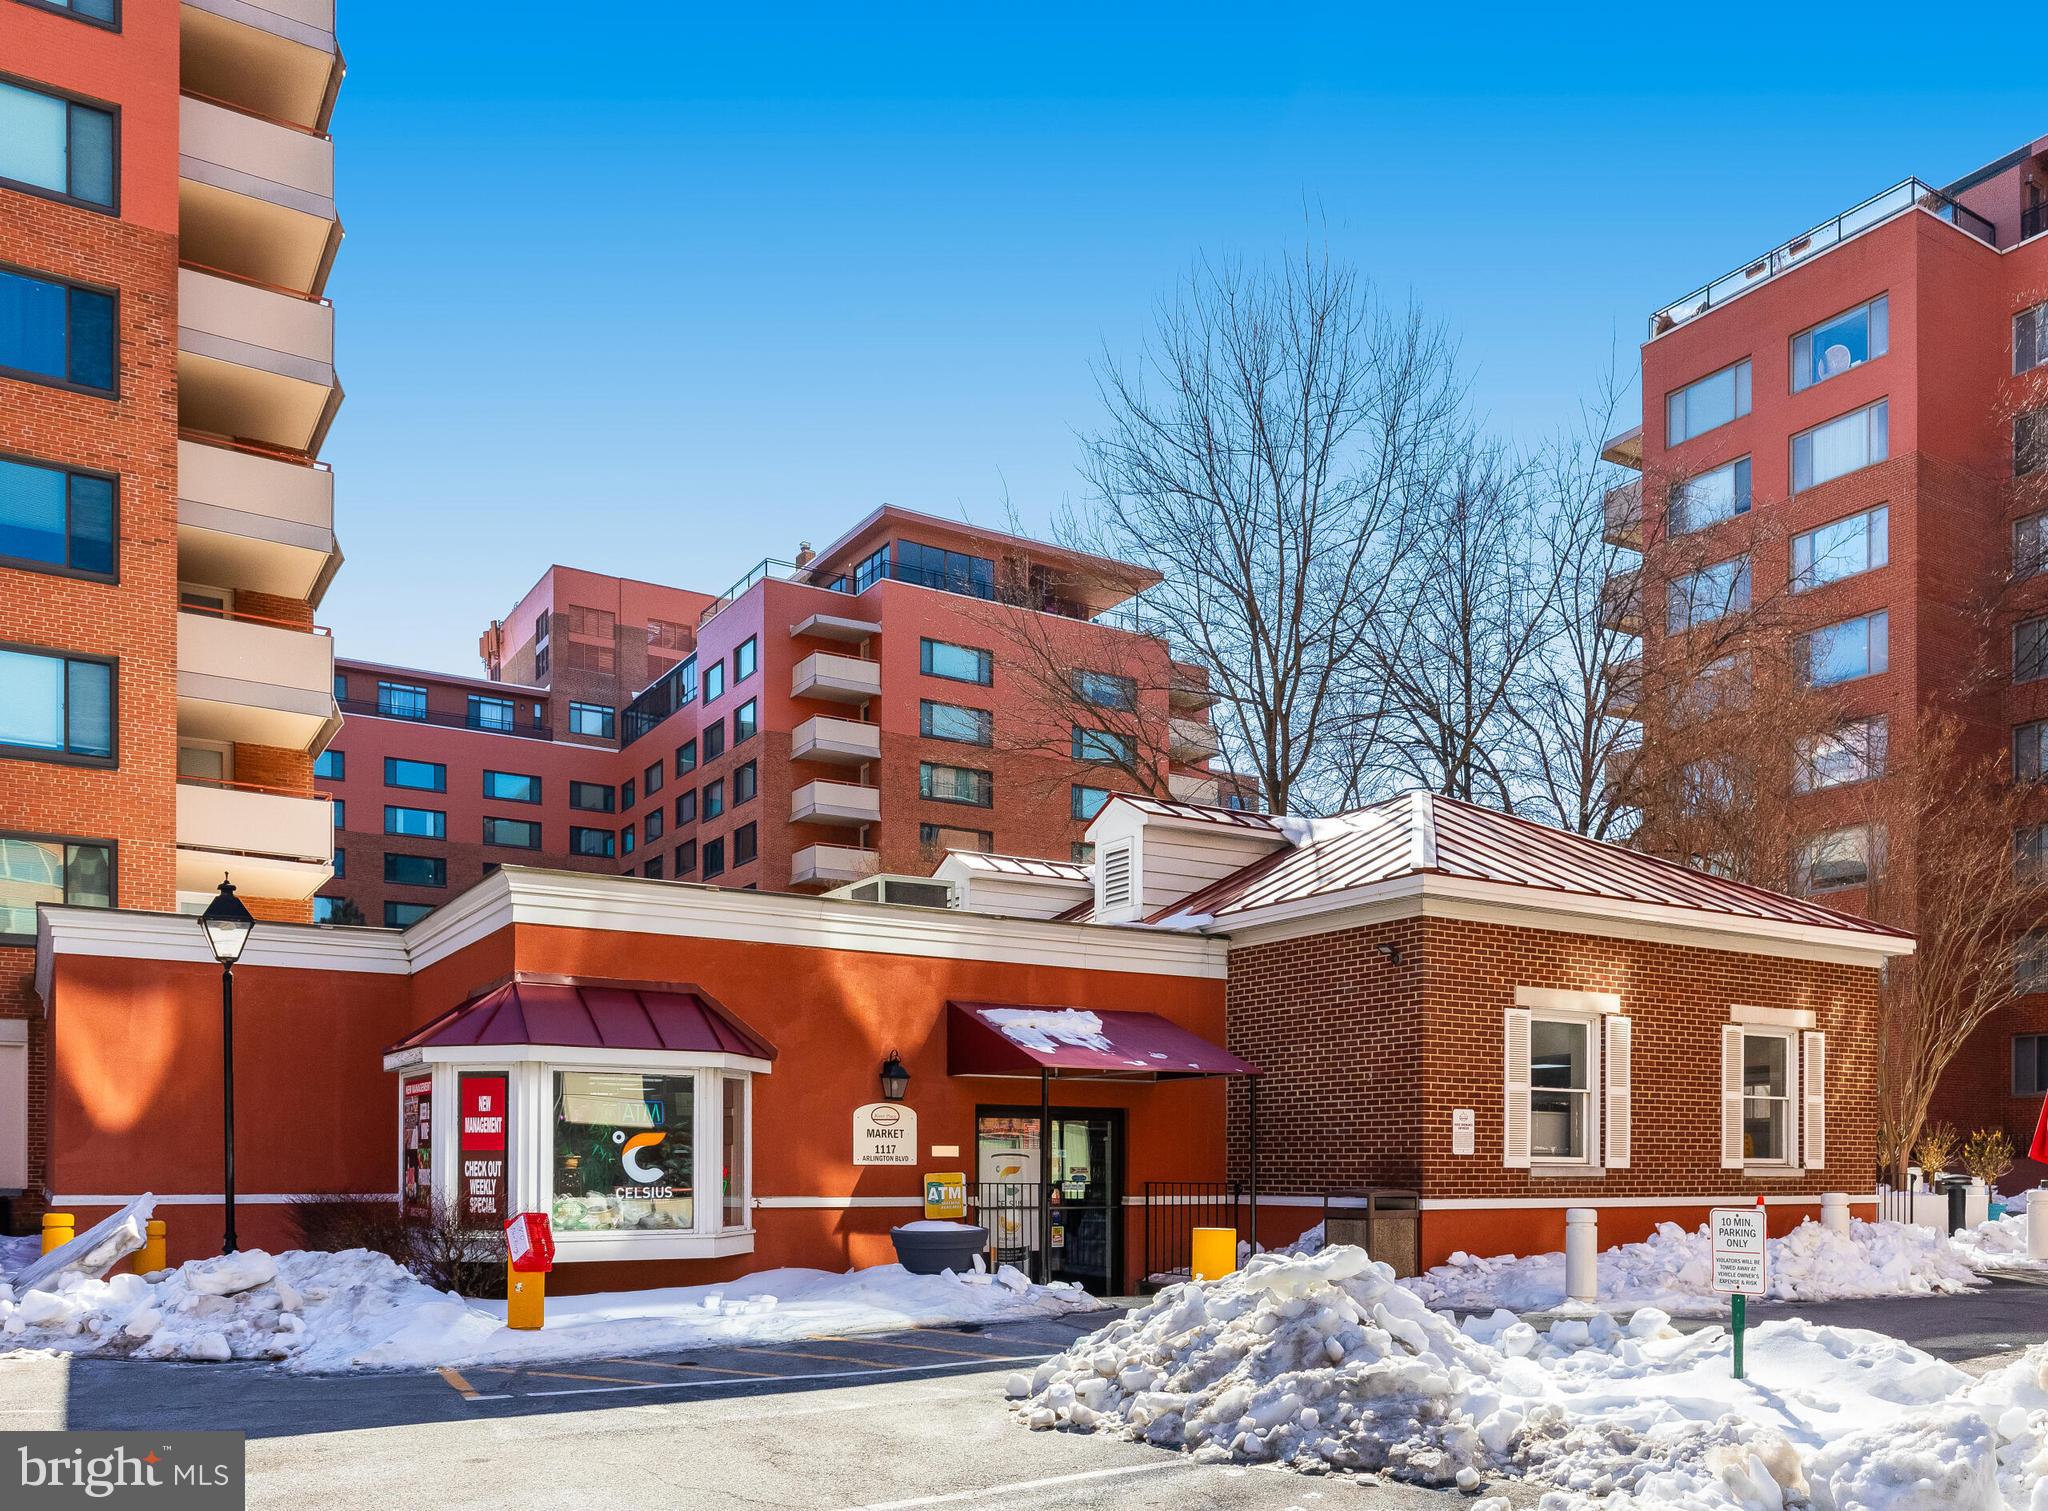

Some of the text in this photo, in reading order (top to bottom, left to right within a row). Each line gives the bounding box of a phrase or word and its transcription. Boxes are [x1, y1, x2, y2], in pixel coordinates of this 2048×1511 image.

[478, 1095, 492, 1112] NEW
[464, 1117, 502, 1133] MANAGEMENT
[866, 1128, 905, 1139] MARKET
[874, 1144, 897, 1154] 1117
[464, 1160, 502, 1177] CHECK OUT
[469, 1179, 497, 1195] WEEKLY
[615, 1186, 673, 1199] CELSIUS
[928, 1186, 961, 1201] ATM
[469, 1197, 497, 1214] SPECIAL
[1721, 1218, 1753, 1227] 10 MIN.
[1720, 1228, 1756, 1237] PARKING
[1726, 1239, 1748, 1248] ONLY
